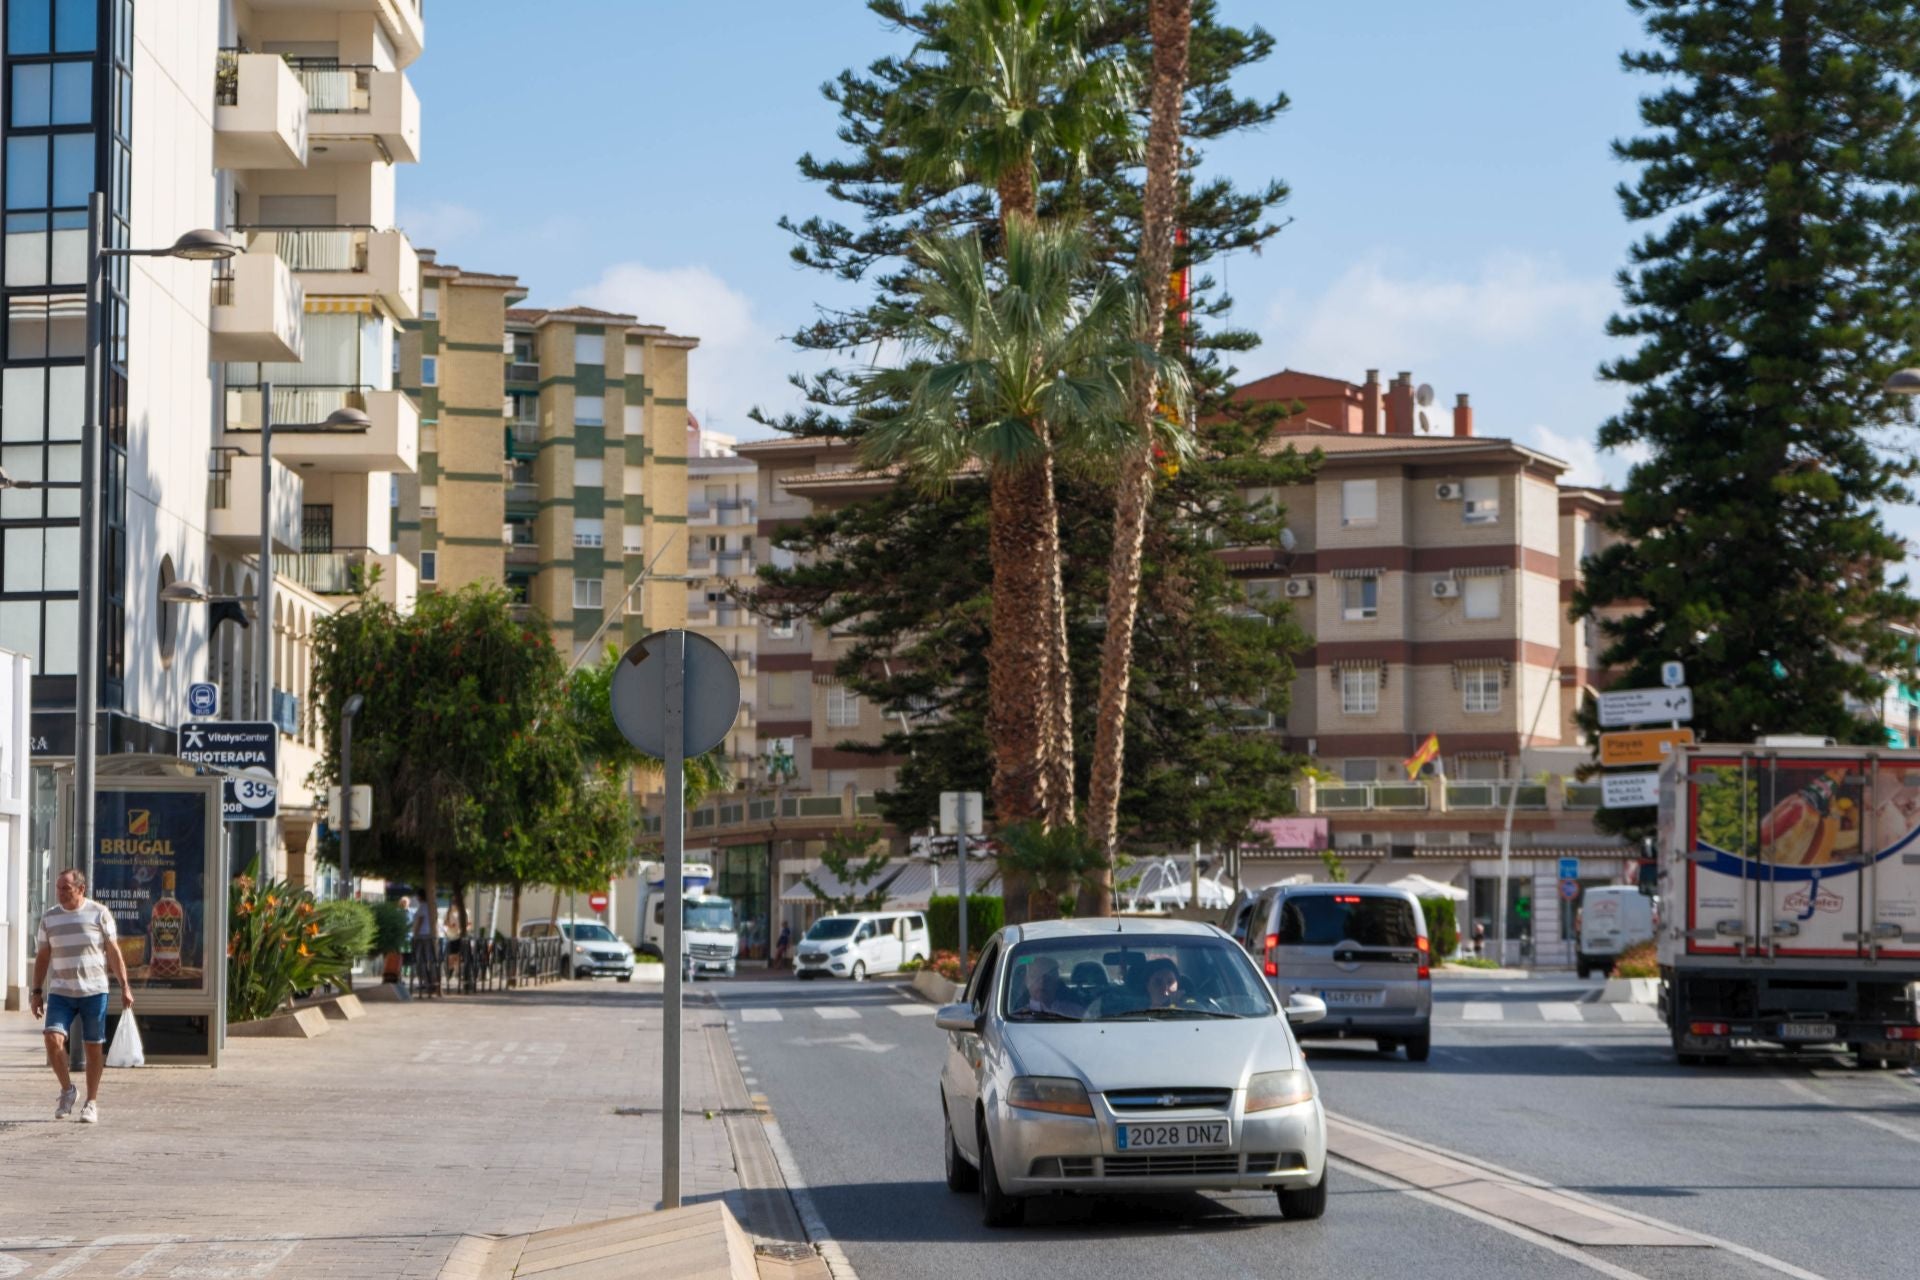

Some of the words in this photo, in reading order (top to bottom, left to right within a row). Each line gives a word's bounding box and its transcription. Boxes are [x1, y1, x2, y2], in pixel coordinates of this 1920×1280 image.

[30, 736, 48, 750] RA
[181, 751, 266, 763] FISIOTERAPIA
[1607, 778, 1646, 787] GRANADA
[223, 803, 243, 813] 008
[101, 839, 175, 855] BRUGAL
[96, 888, 109, 898] MÁS
[1131, 1128, 1179, 1146] 2028
[1187, 1126, 1222, 1143] DNZ
